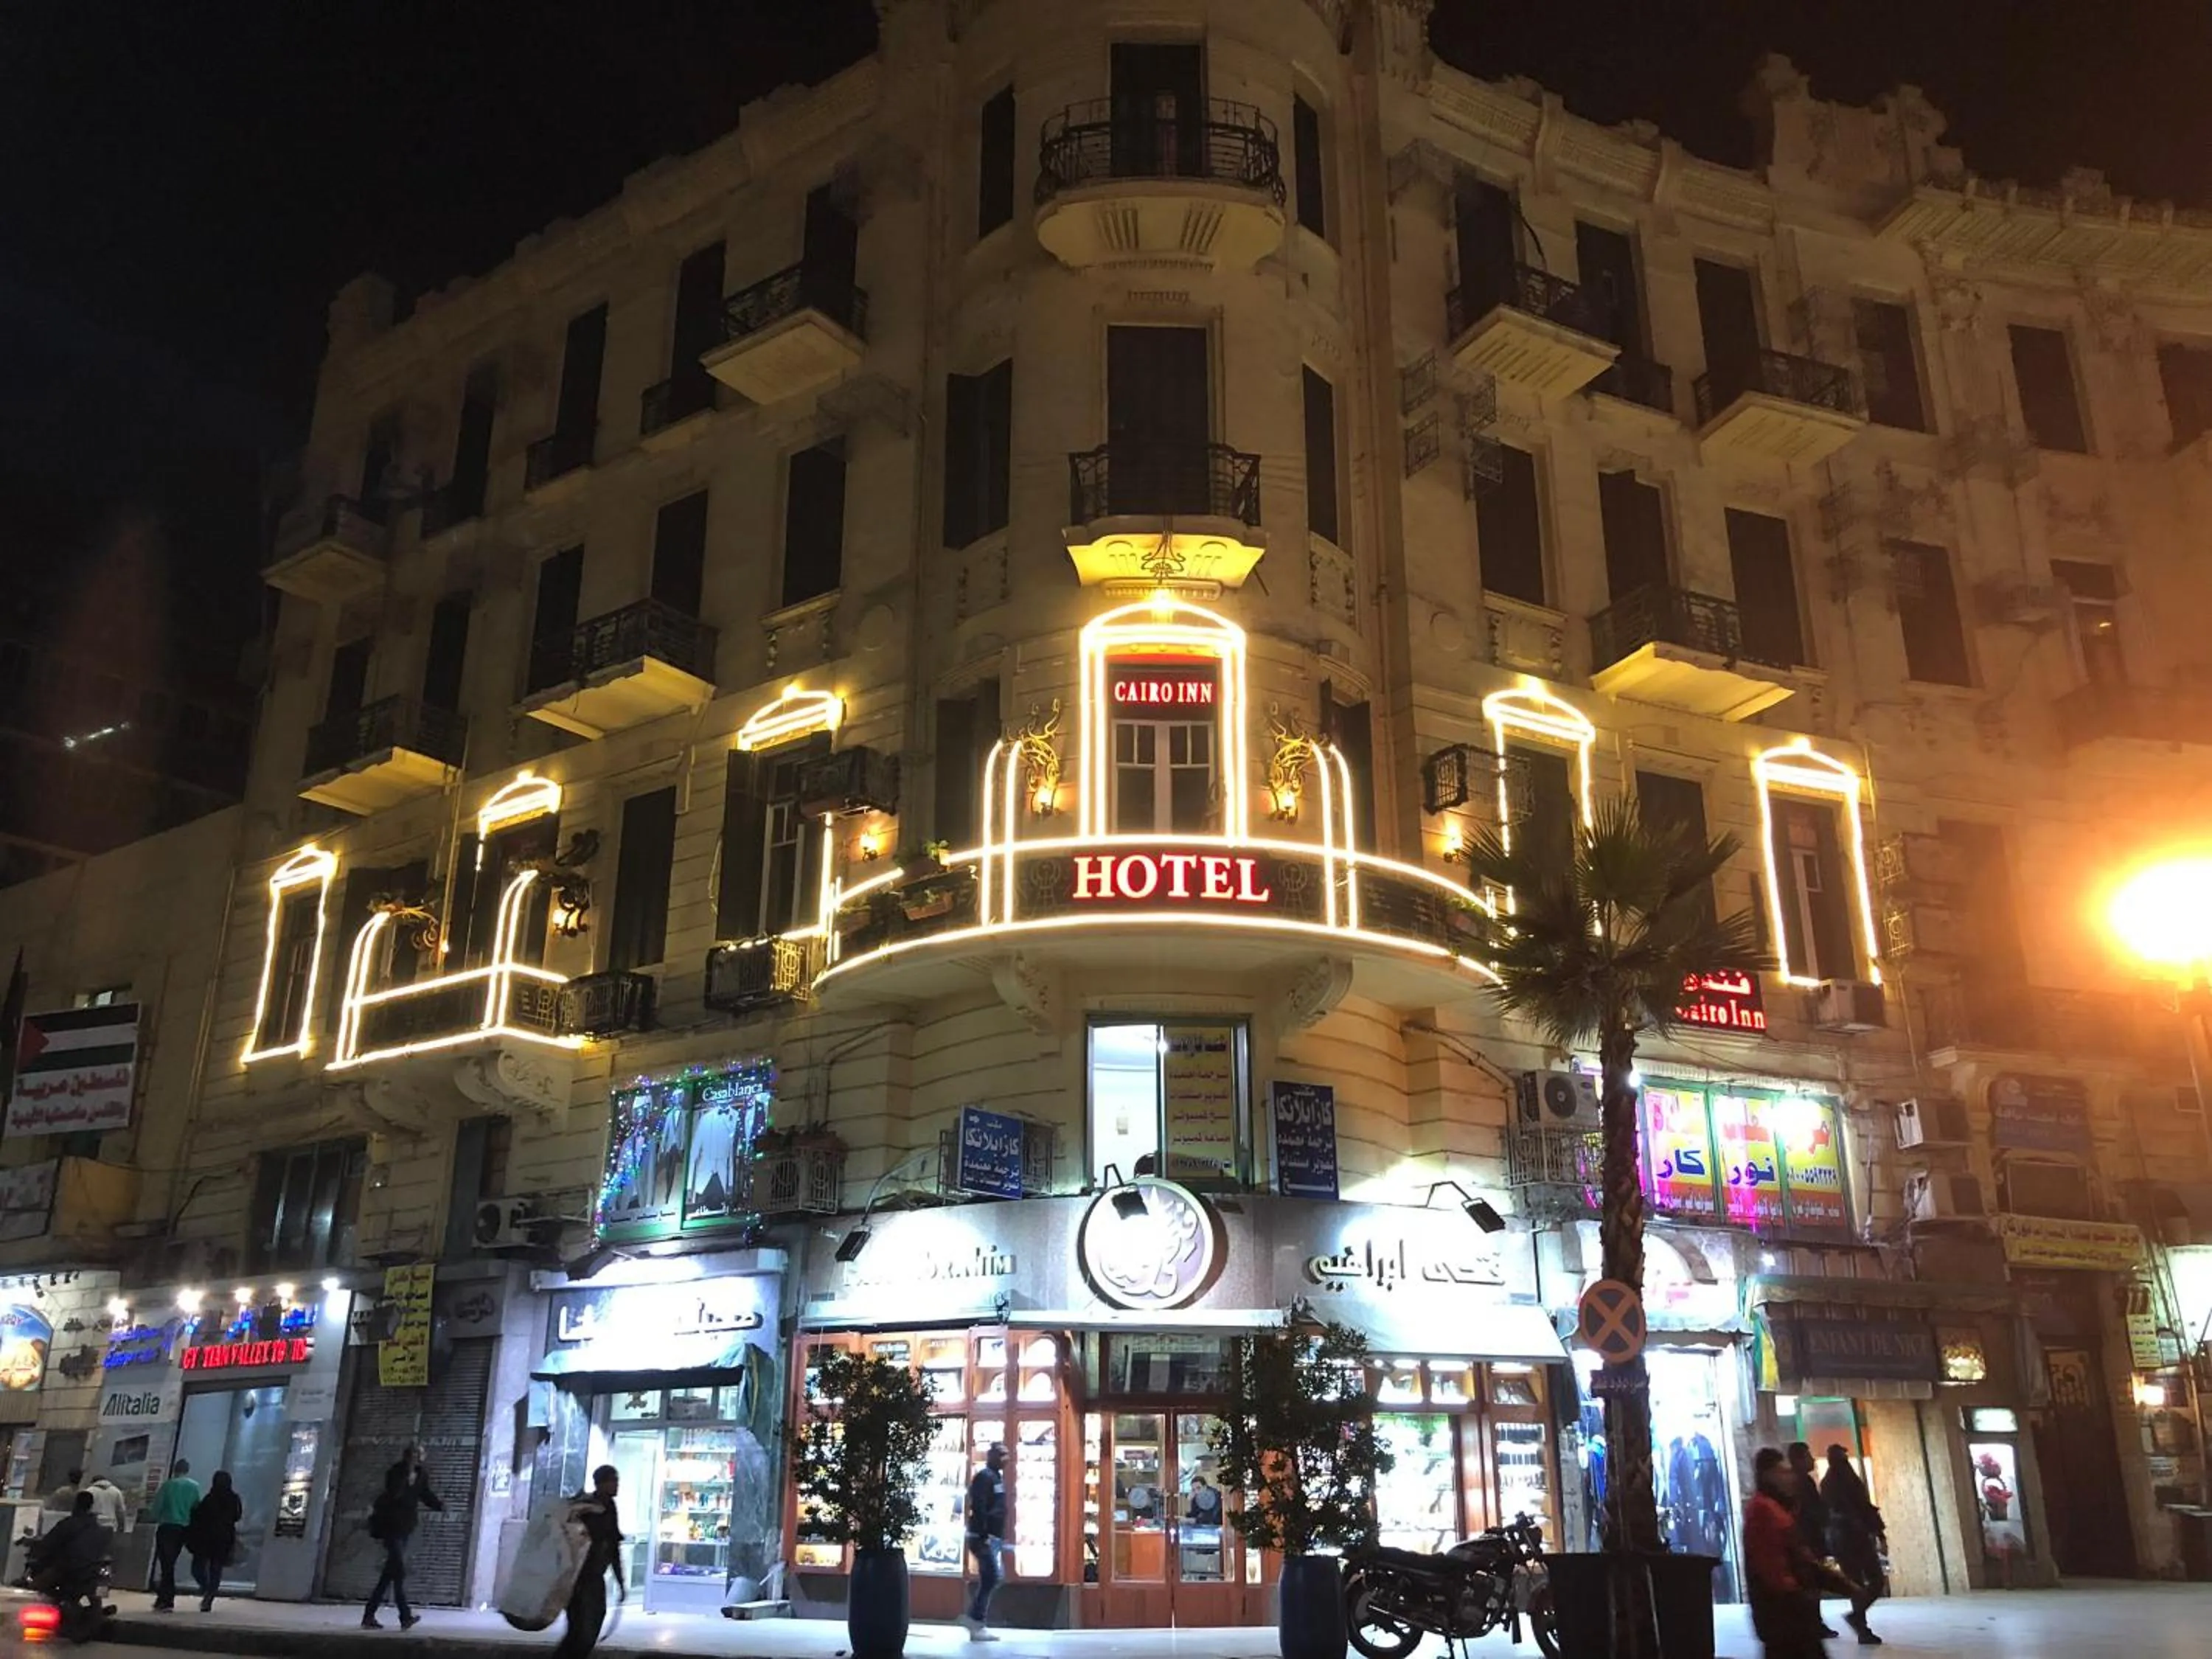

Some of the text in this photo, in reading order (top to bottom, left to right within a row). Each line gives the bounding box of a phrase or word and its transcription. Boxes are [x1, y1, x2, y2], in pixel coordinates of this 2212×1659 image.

[1115, 681, 1214, 703] CAIRO INN
[1072, 853, 1270, 902] HOTEL
[1729, 999, 1767, 1029] Inn
[702, 1081, 764, 1102] Casablanca
[965, 1128, 1020, 1157] كازابلانكا
[1656, 1148, 1776, 1187] نور كار
[102, 1391, 160, 1416] Alitalia
